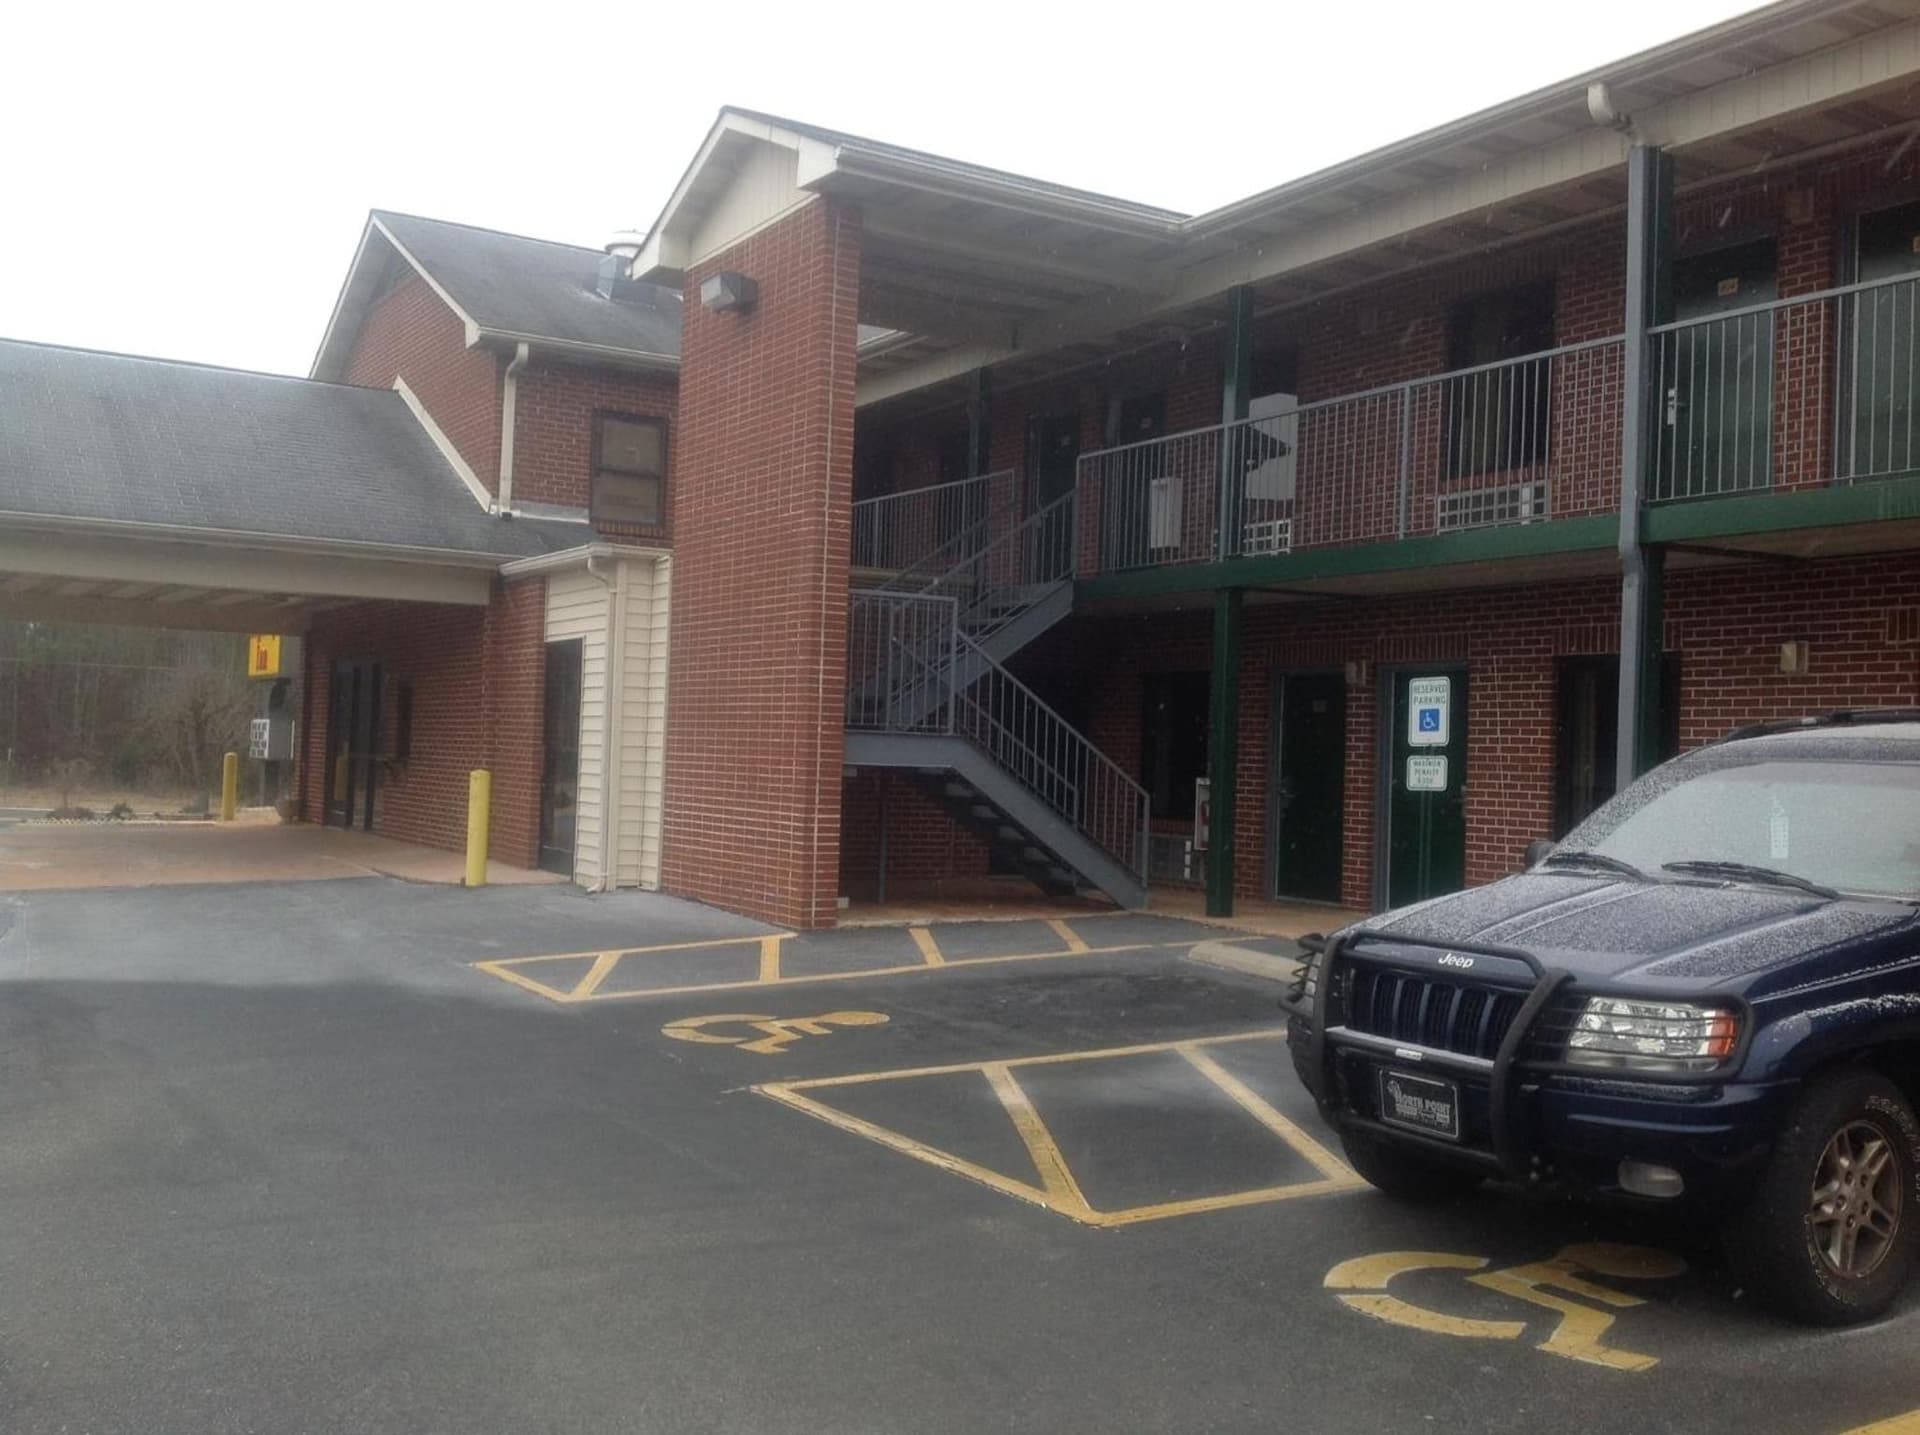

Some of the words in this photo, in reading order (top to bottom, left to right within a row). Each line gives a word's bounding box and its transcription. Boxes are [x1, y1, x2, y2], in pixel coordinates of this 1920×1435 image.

[1412, 684, 1447, 694] RESERVED
[1412, 695, 1447, 705] PARKING
[1438, 952, 1474, 968] Jeep
[1424, 1098, 1451, 1117] POINT
